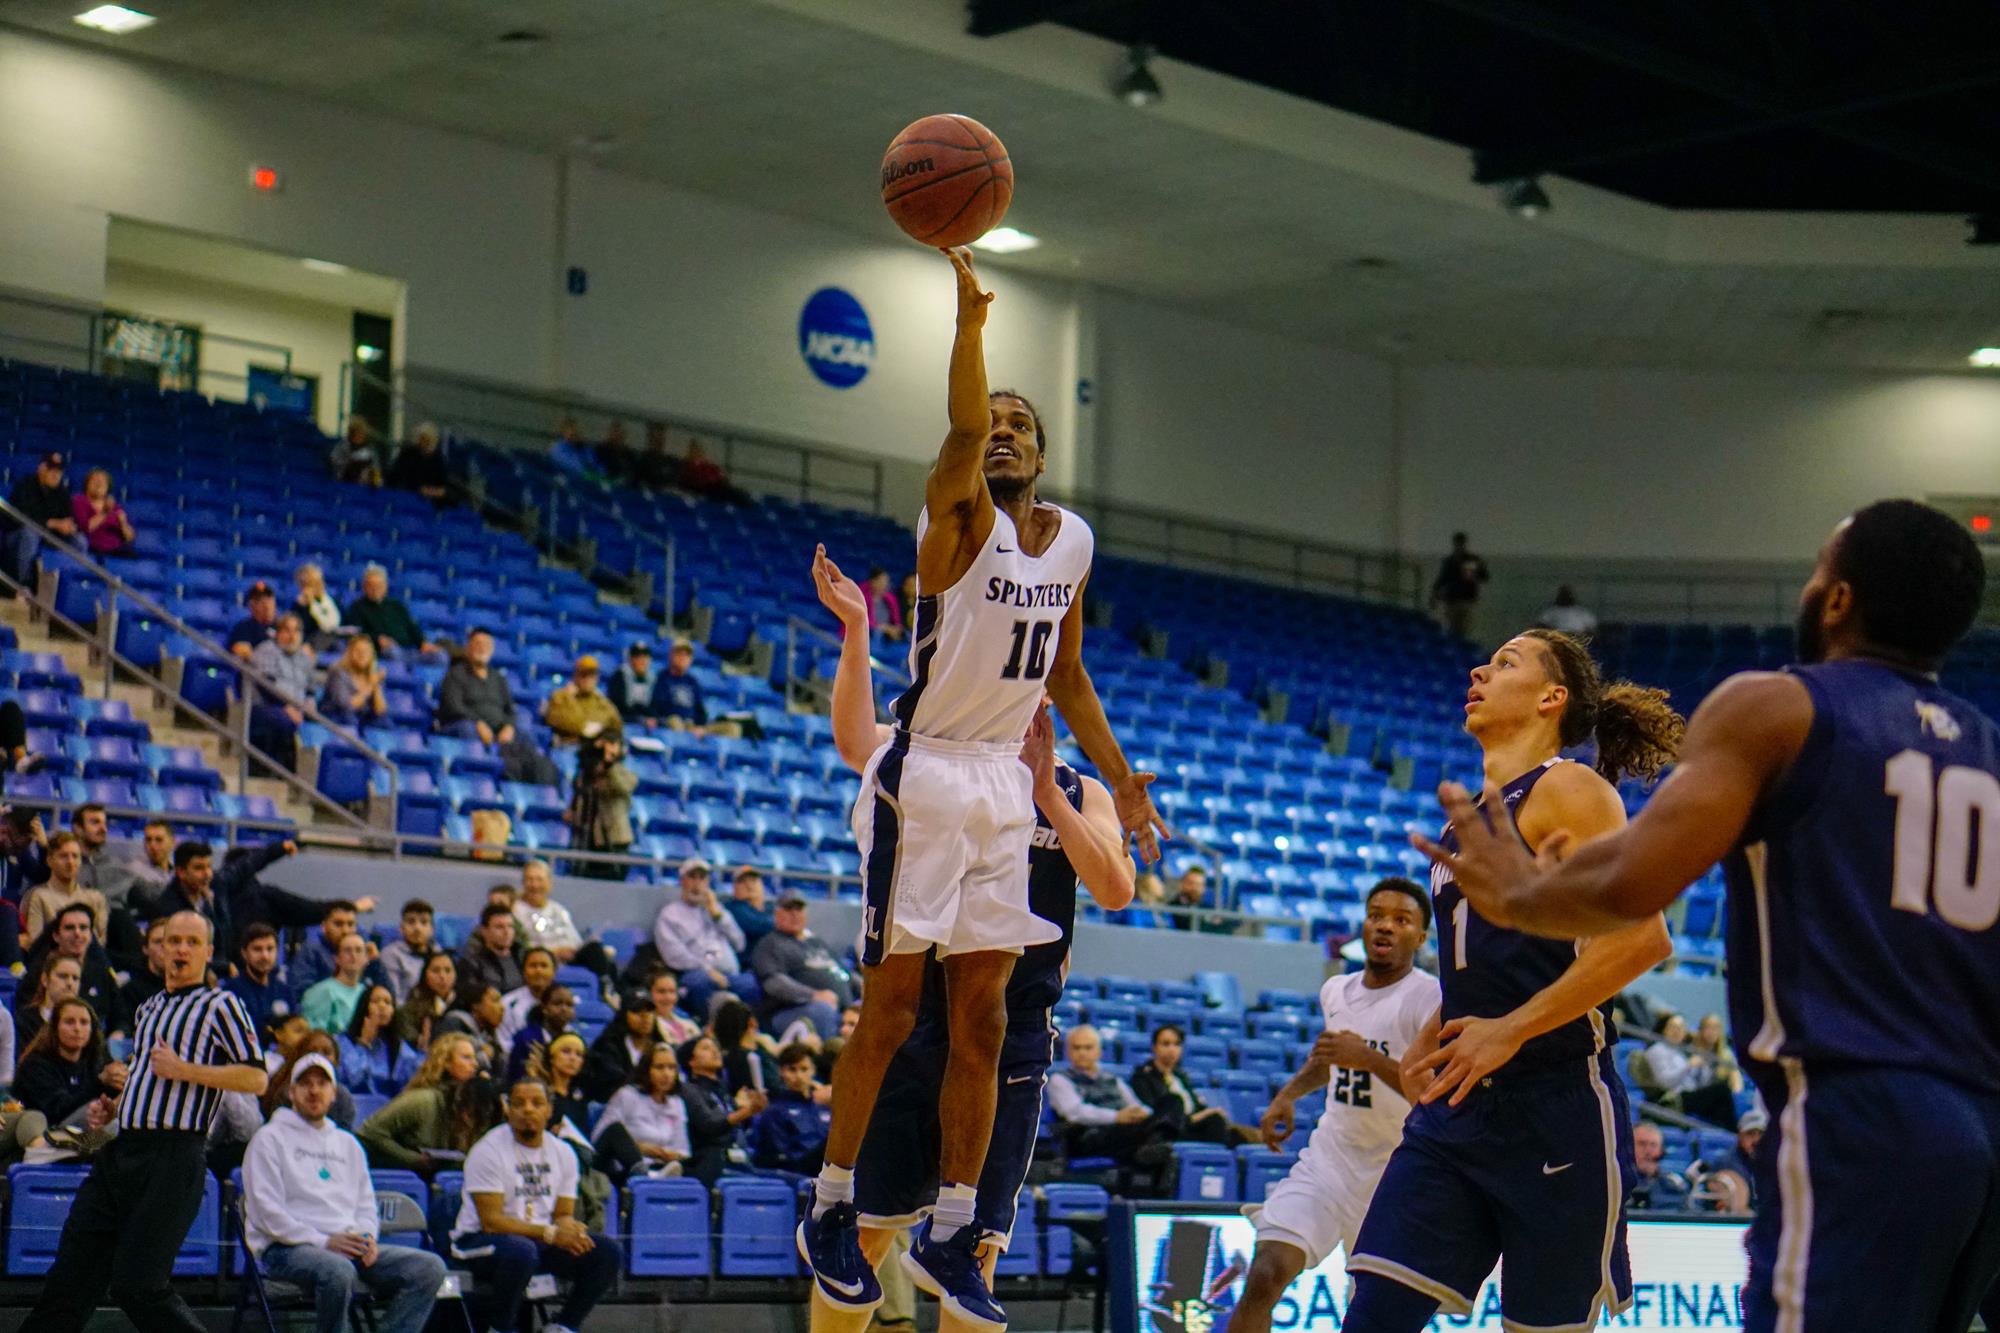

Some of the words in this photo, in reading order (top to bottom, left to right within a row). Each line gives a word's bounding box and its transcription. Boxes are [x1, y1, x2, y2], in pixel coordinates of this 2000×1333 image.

[985, 576, 1071, 608] SPLITTERS
[1000, 619, 1053, 680] 10
[1884, 748, 2000, 932] 10
[867, 905, 879, 941] L
[1452, 896, 1469, 971] 1
[1334, 1066, 1372, 1109] 22
